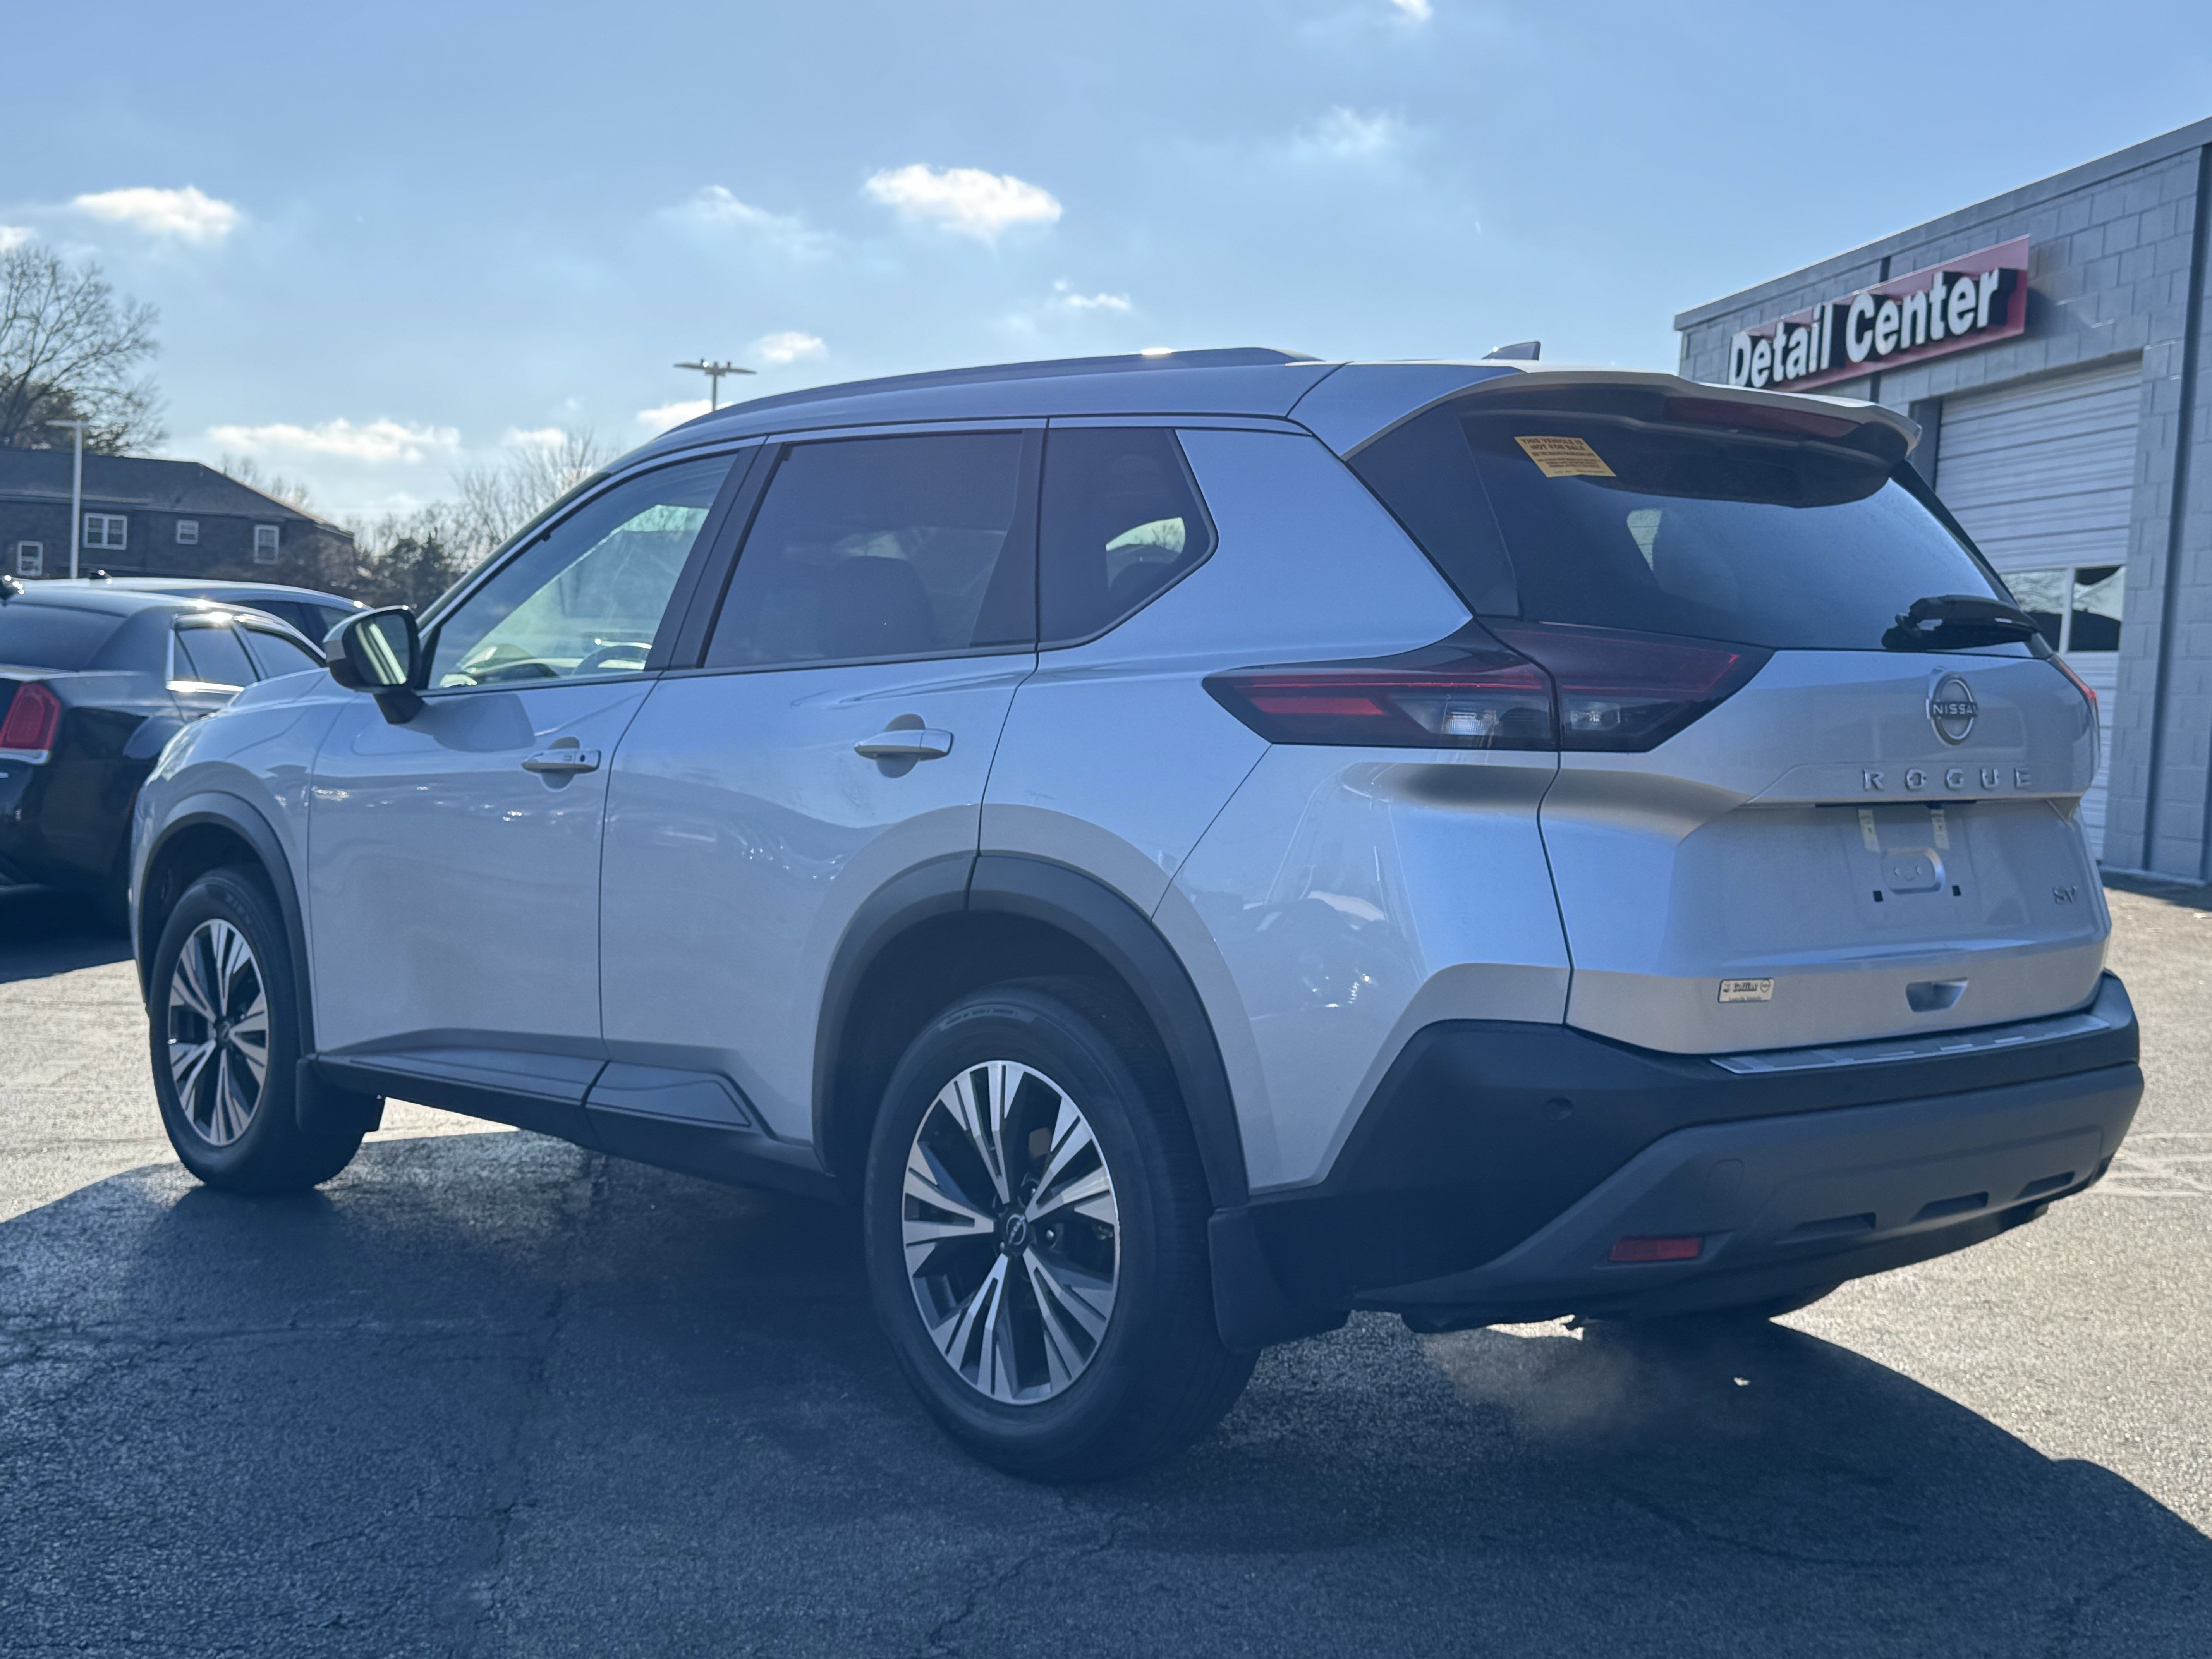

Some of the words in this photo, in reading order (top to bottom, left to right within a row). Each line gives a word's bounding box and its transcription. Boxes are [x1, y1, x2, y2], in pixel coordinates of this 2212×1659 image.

[1729, 304, 1834, 388] Detail
[1846, 267, 1999, 363] Center
[1863, 768, 2032, 791] ROGUE
[2053, 885, 2077, 905] SV
